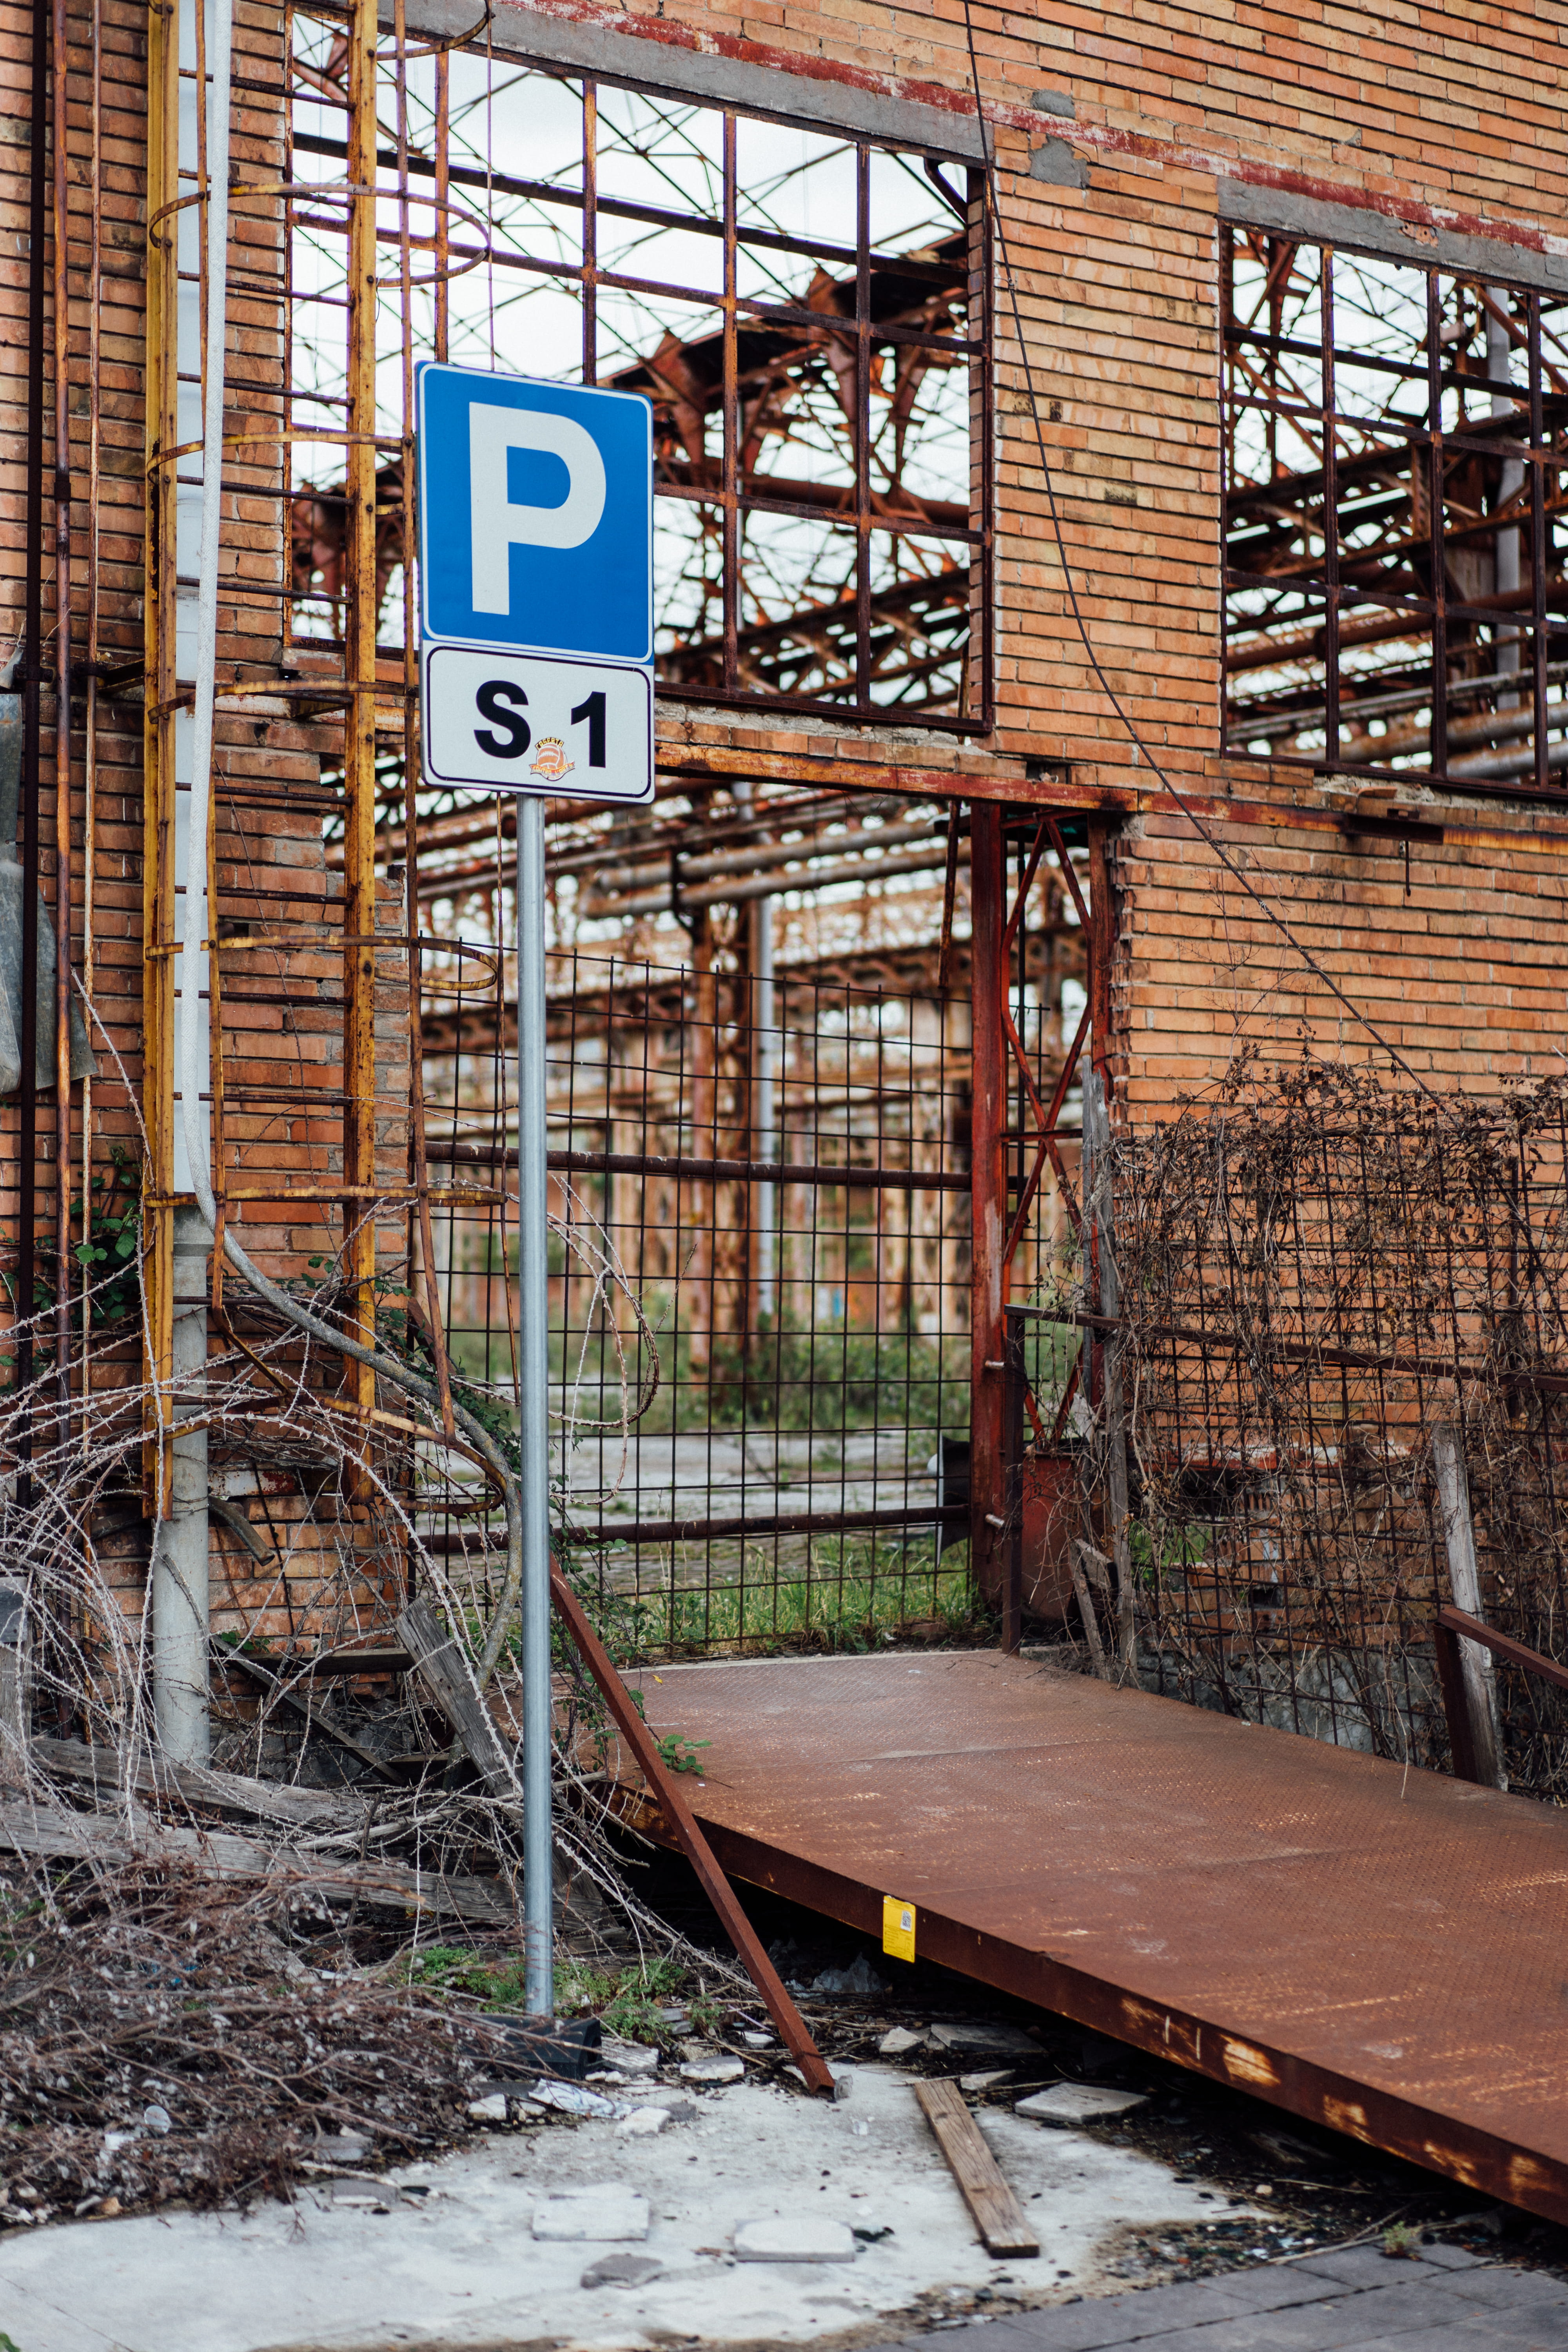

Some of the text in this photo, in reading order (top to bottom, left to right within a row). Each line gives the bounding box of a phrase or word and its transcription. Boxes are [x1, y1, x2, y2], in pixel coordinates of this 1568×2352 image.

[469, 401, 606, 615] P
[474, 680, 606, 768] S 1
